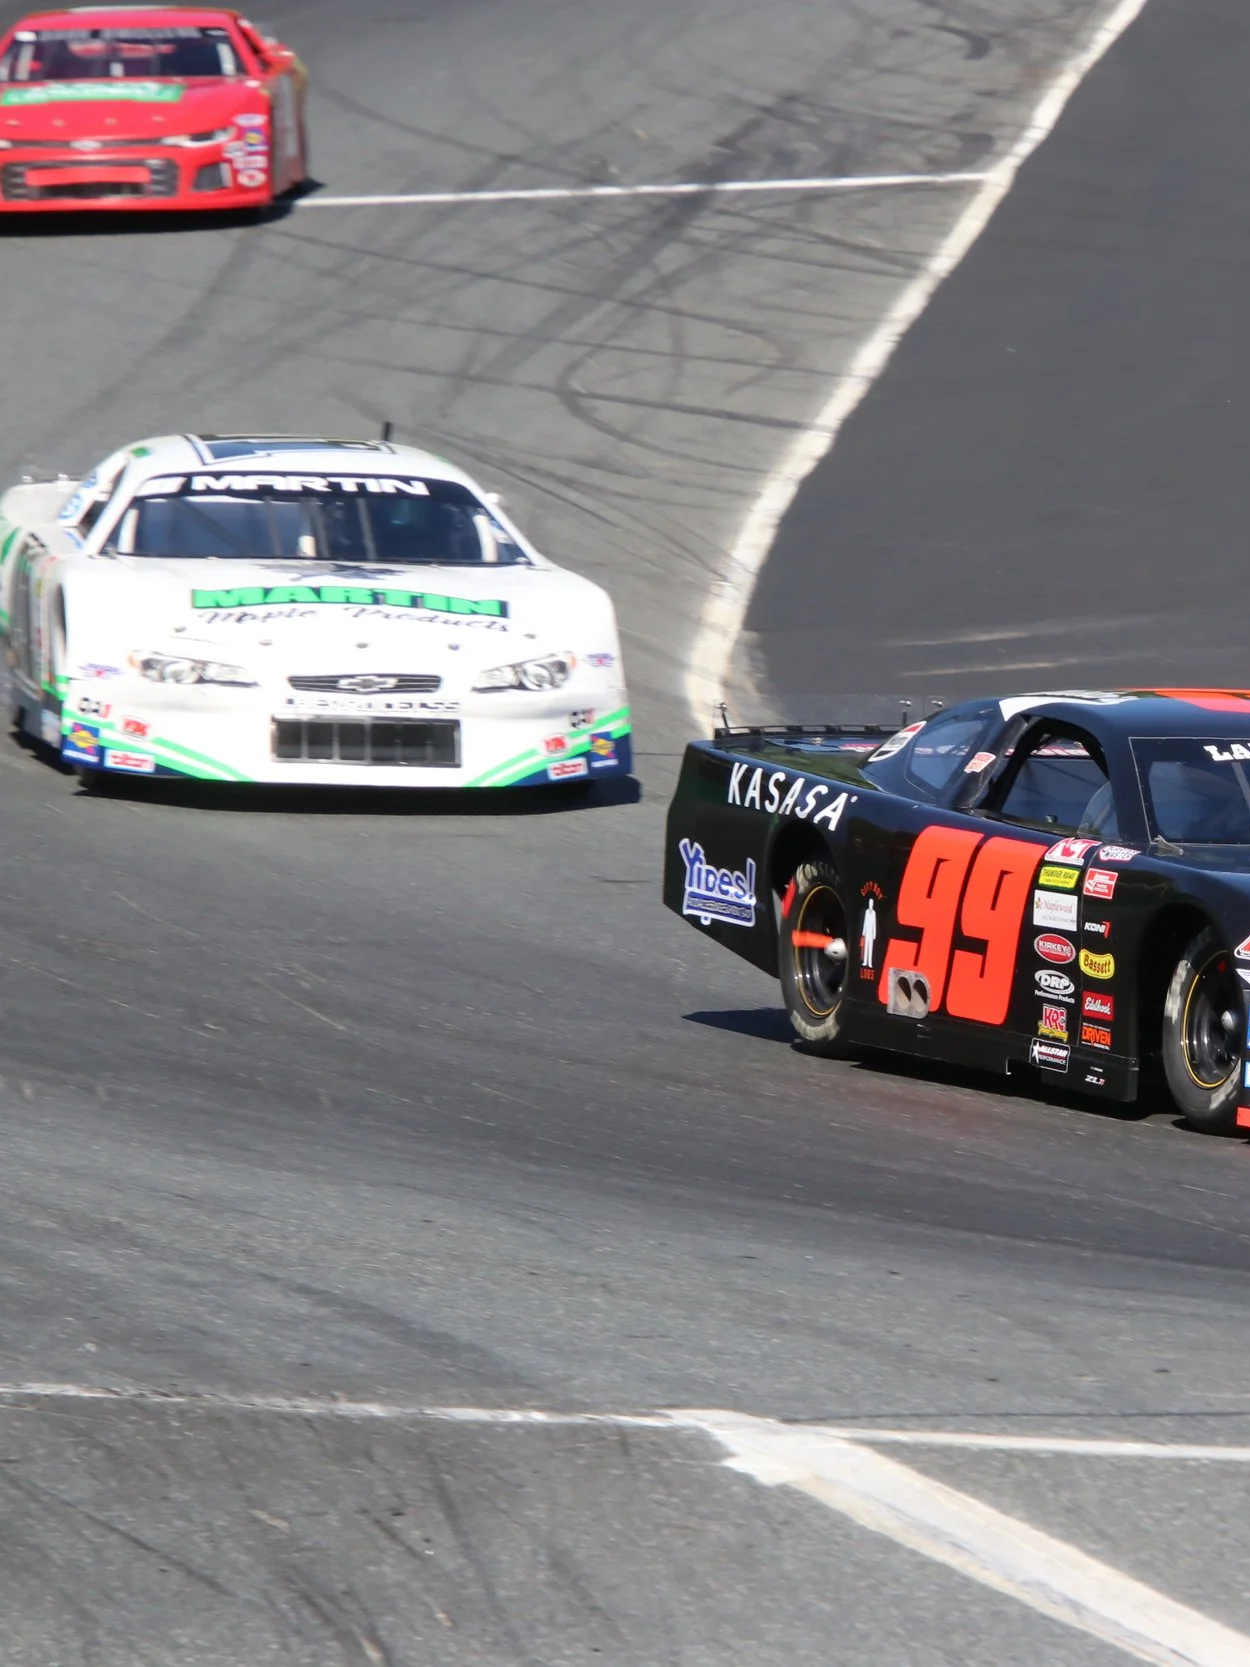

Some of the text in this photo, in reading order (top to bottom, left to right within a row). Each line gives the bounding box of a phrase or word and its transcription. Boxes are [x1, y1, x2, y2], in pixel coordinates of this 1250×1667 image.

[192, 475, 430, 496] MARTIN
[191, 586, 509, 619] MARTIN
[197, 606, 510, 632] Maple Products
[728, 762, 849, 831] KASASA
[878, 825, 1049, 1025] 99
[1084, 921, 1106, 933] KONI
[1039, 940, 1067, 952] KIRKEY
[1083, 953, 1112, 974] Bassett
[1040, 974, 1070, 989] DRP
[1082, 1025, 1111, 1046] DRIVEN
[1038, 1045, 1069, 1058] ALLSTAR
